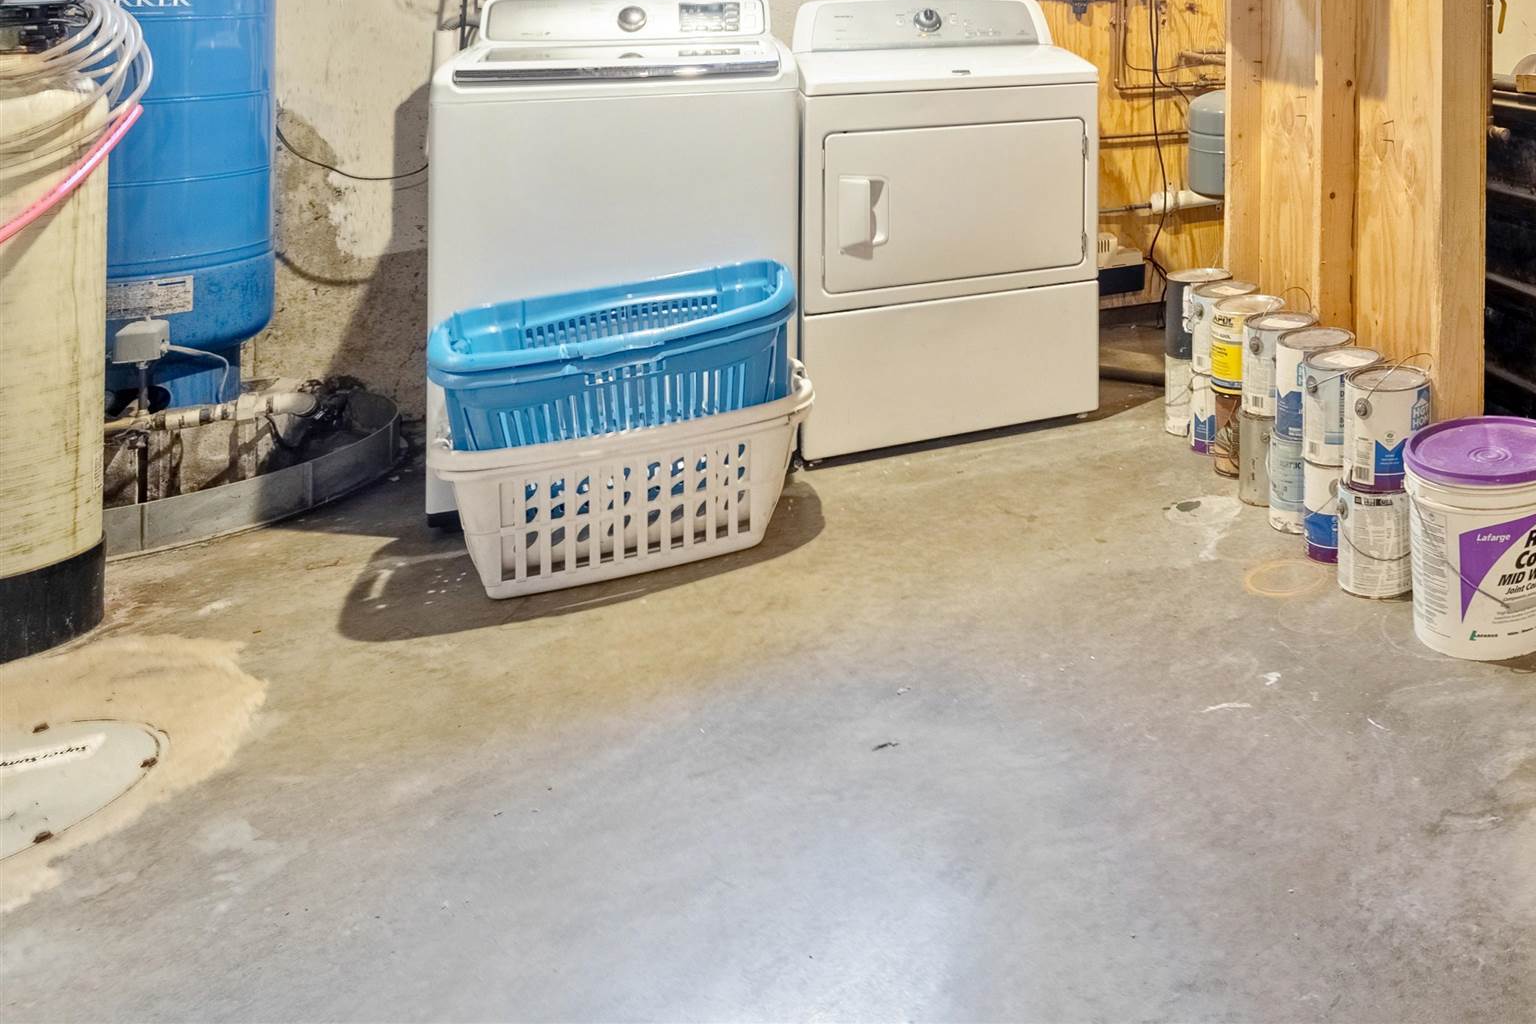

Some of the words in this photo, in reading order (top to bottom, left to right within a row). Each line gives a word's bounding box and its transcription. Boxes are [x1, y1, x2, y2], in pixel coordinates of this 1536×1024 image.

[1476, 533, 1511, 543] Lafarge
[1498, 572, 1526, 586] MID
[1505, 583, 1524, 595] Joint
